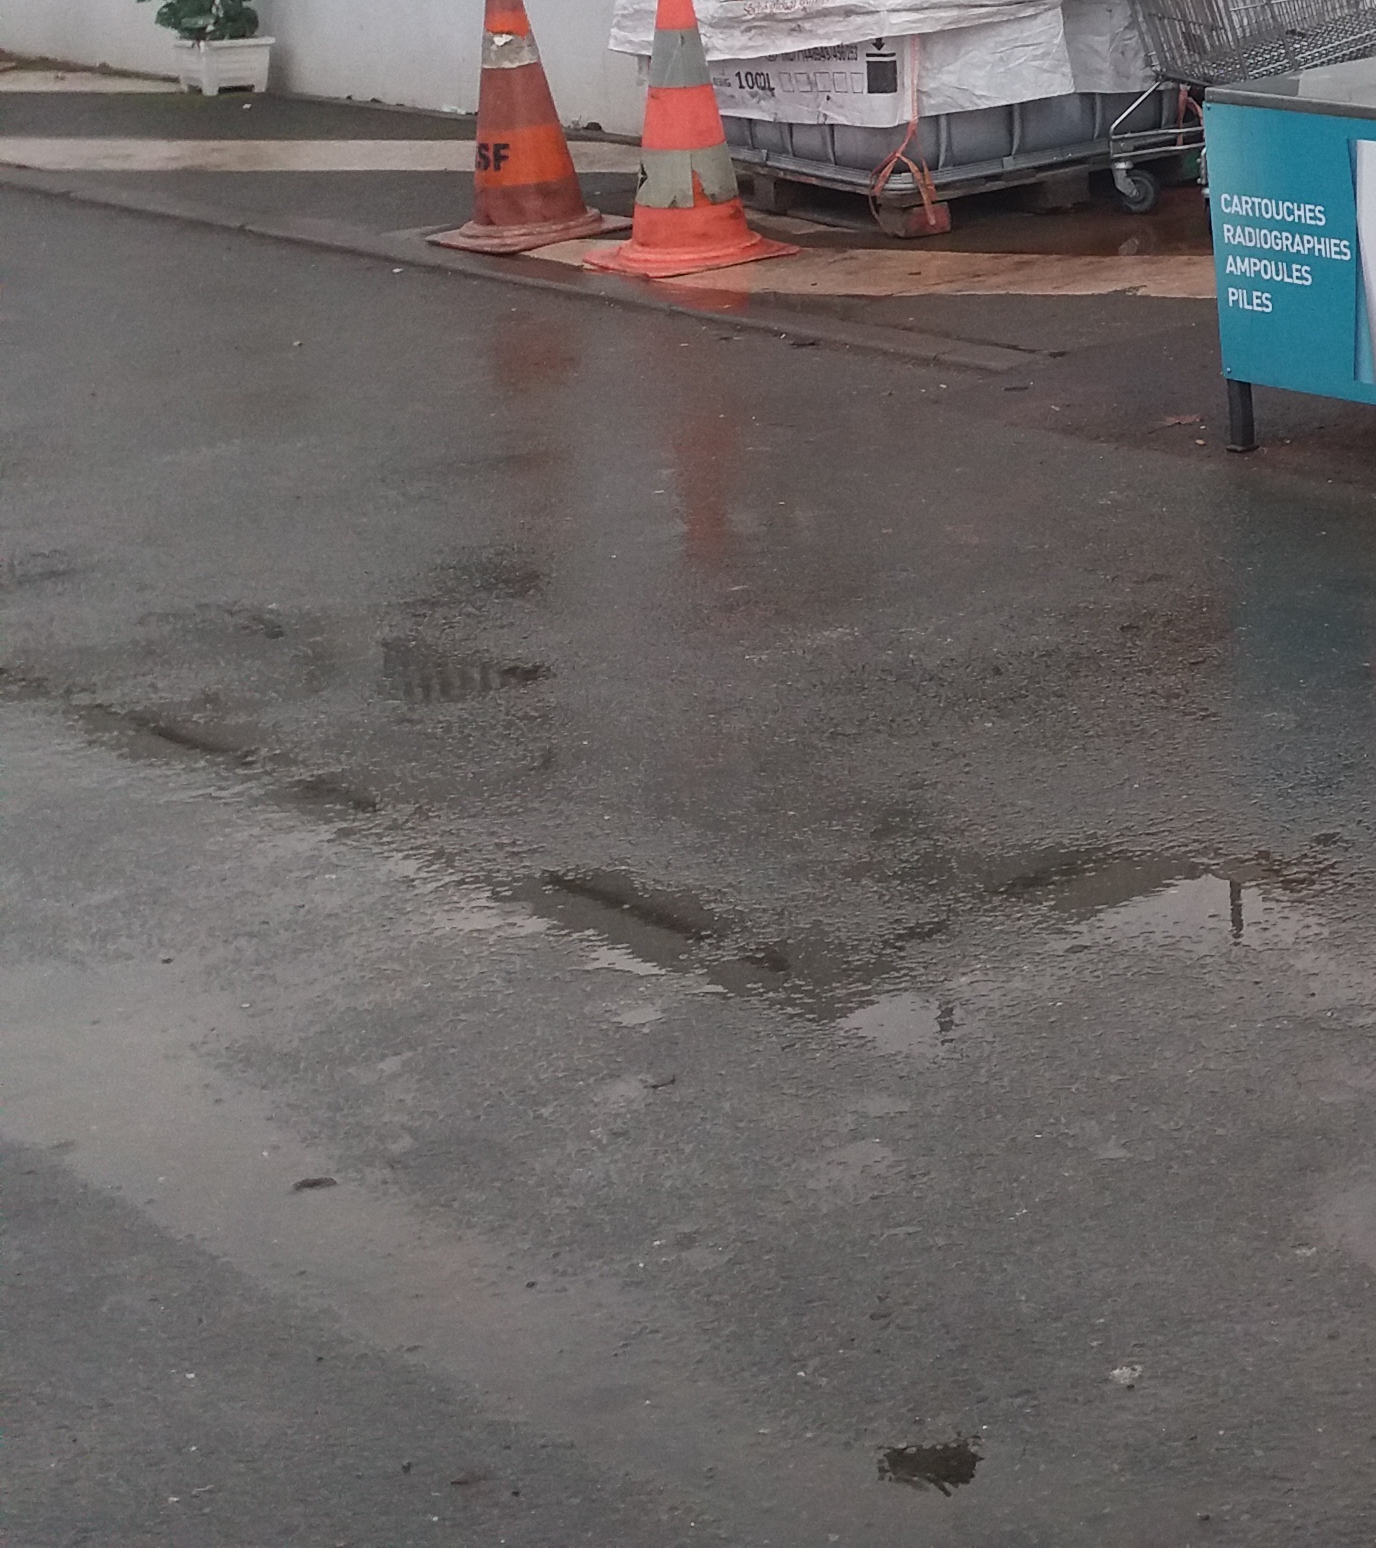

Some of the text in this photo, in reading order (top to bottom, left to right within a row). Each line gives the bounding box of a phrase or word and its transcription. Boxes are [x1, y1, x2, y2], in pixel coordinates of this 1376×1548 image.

[1220, 193, 1326, 226] CARTOUCHES
[1223, 224, 1351, 261] RADIOGRAPHIES
[1225, 256, 1313, 286] AMPOULES
[1227, 288, 1273, 312] PILES
